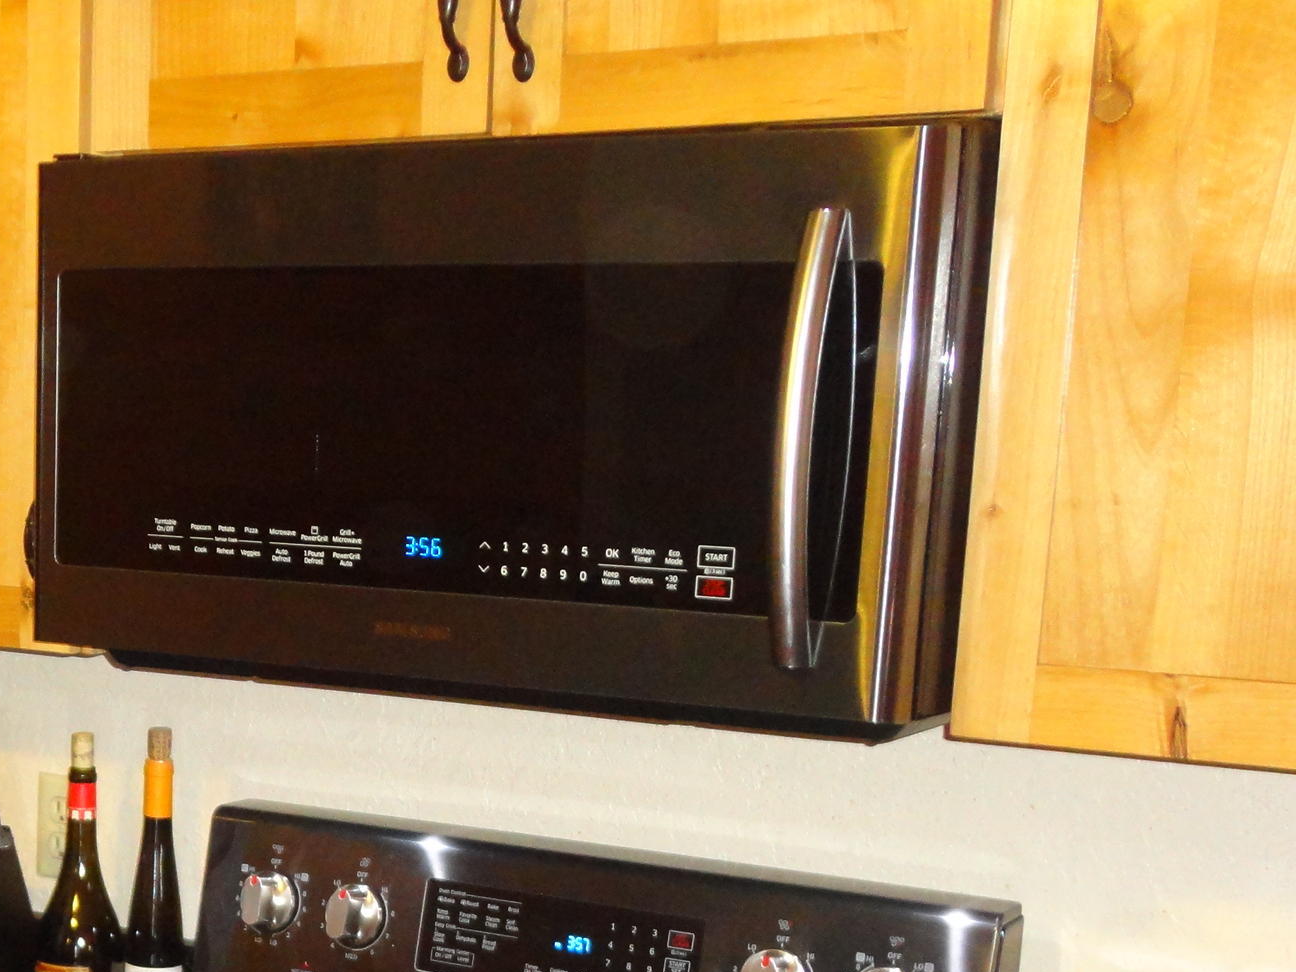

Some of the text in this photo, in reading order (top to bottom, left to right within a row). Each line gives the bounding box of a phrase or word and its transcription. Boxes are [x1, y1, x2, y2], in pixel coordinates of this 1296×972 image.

[190, 523, 212, 531] Popcorn
[244, 526, 258, 534] Pizza
[269, 528, 296, 536] Microwave
[301, 534, 328, 542] PowerGrill
[332, 536, 362, 544] Microwave
[216, 547, 234, 555] Reheat
[405, 536, 442, 558] 3:56
[503, 541, 588, 557] 1 2 3 4 5
[632, 547, 655, 556] Kitchen
[240, 549, 261, 557] Veggies
[333, 552, 360, 560] PowerGrill
[605, 548, 619, 558] OK
[668, 549, 681, 557] Eco
[705, 553, 728, 561] START
[634, 555, 652, 563] Timer
[665, 557, 683, 566] Mode
[500, 565, 587, 581] 6 7 8 9 0
[603, 570, 619, 580] Keep
[601, 577, 621, 586] Warm
[629, 575, 654, 586] Options
[611, 922, 658, 937] 1 2 3
[608, 941, 655, 956] 4 5 6
[605, 958, 611, 967] 7
[626, 962, 632, 971] 8
